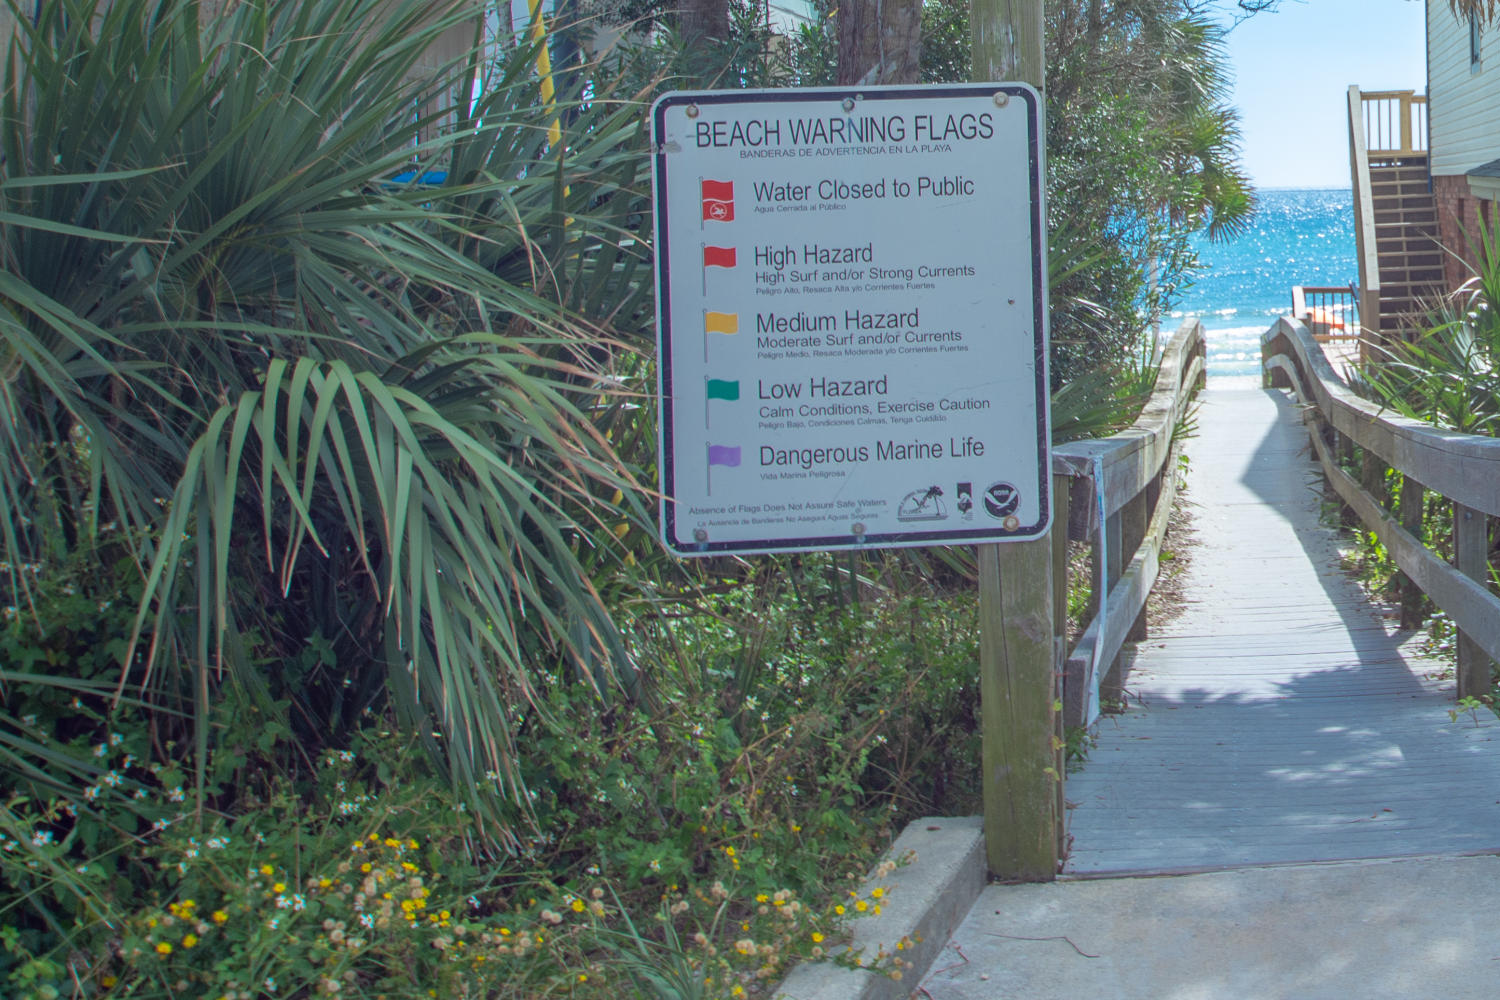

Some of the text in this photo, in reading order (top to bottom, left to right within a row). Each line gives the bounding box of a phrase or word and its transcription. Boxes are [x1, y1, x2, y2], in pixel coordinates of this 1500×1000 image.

[696, 113, 994, 148] BEACH WARNING FLAGS
[740, 144, 952, 159] BANDERAS DE ADVERTENCIA EN LA PLAYA
[753, 176, 975, 202] Water Closed to Public
[754, 205, 774, 214] Agua
[776, 204, 808, 212] Cerrada
[810, 203, 817, 211] al
[754, 242, 873, 271] High Hazard
[755, 265, 975, 286] High Surf and/or Strong Currents
[756, 287, 782, 296] Peligro
[834, 285, 849, 293] Alta
[865, 283, 904, 291] Corrientes
[756, 307, 919, 333] Medium Hazard
[757, 330, 962, 349] Moderate Surf and/or Currents
[757, 351, 784, 360] Peligro
[813, 349, 842, 357] Resaca
[844, 348, 883, 356] Moderada
[898, 346, 938, 354] Corrientes
[758, 374, 887, 399] Low Hazard
[759, 398, 990, 418] Calm Conditions, Exercise Caution
[758, 422, 784, 430] Peligro
[808, 419, 855, 427] Condiciones
[890, 416, 913, 424] Tenga
[760, 437, 985, 469] Dangerous Marine Life
[760, 470, 846, 480] Vida Marina Peligrosa
[689, 499, 887, 515] Absence of Flags Does Not Assure Safe Waters
